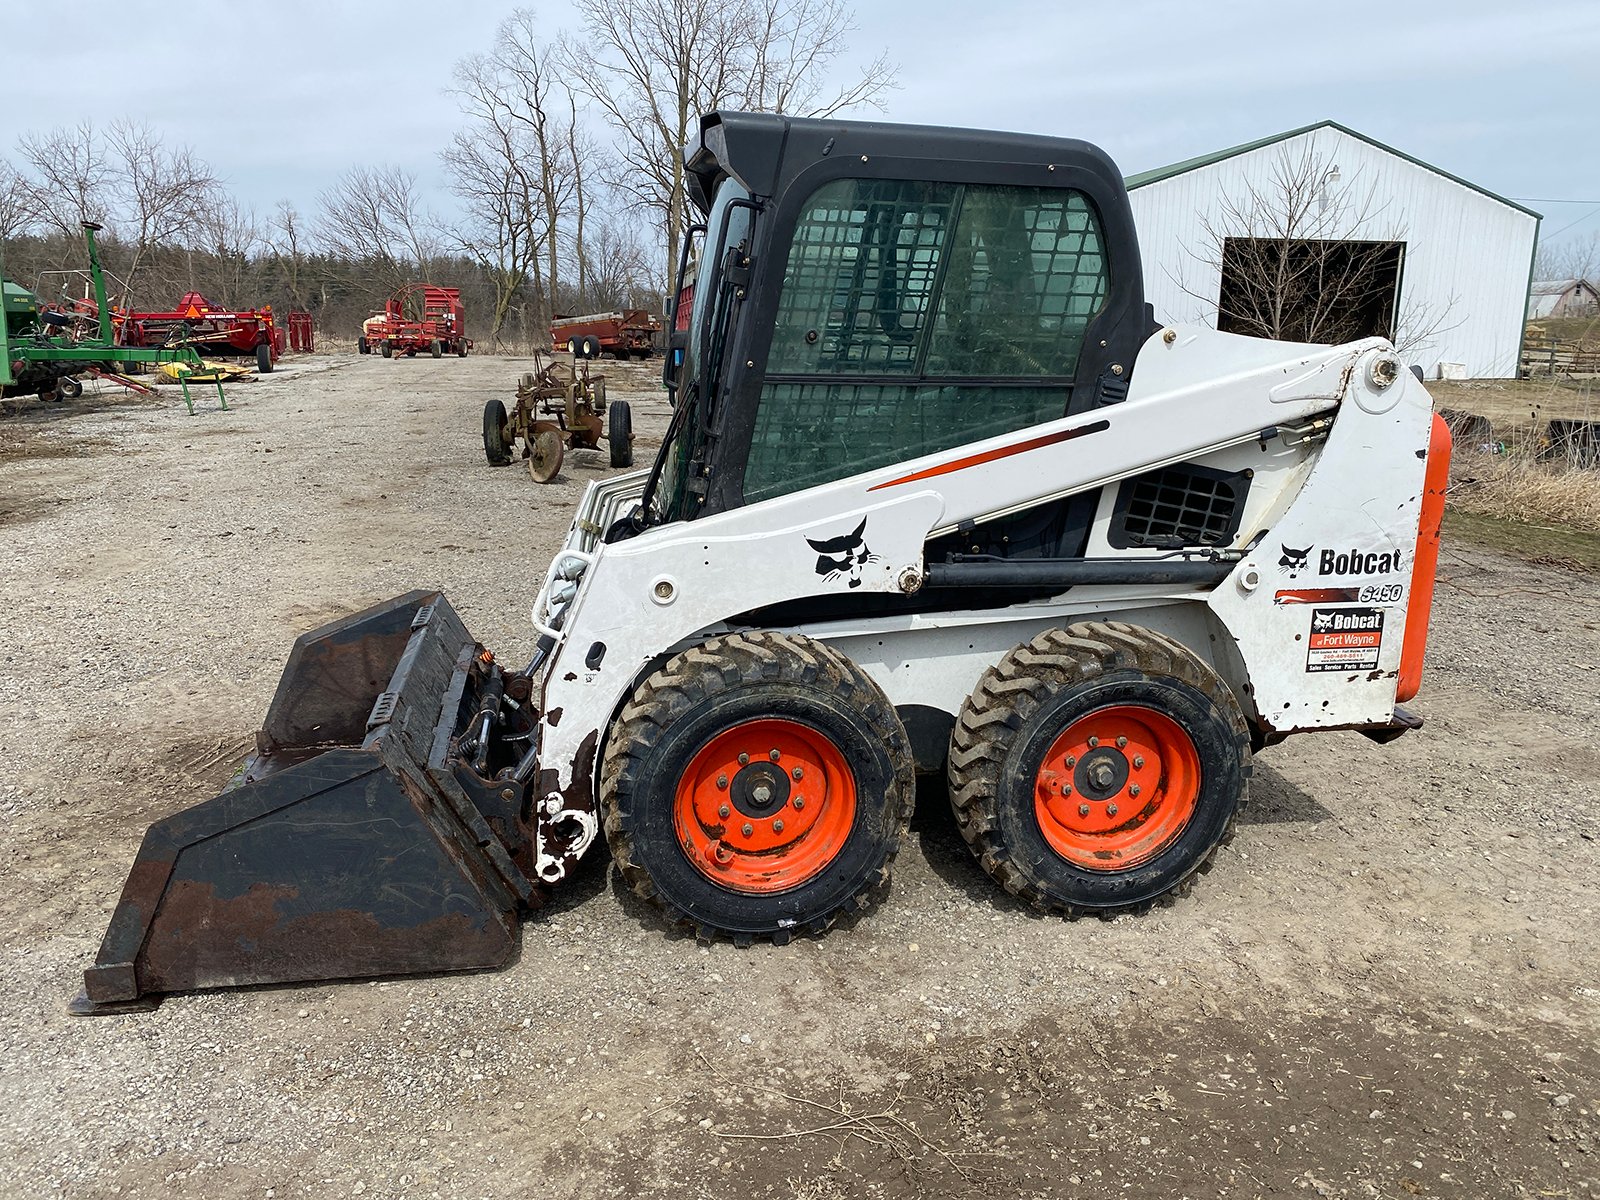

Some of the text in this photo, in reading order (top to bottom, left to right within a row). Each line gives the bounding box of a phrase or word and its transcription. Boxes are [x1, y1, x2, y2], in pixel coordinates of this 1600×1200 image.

[1319, 549, 1401, 575] Bobcat
[1334, 614, 1381, 629] Bobcat
[1324, 635, 1342, 645] Fort
[1344, 634, 1374, 646] Wayne
